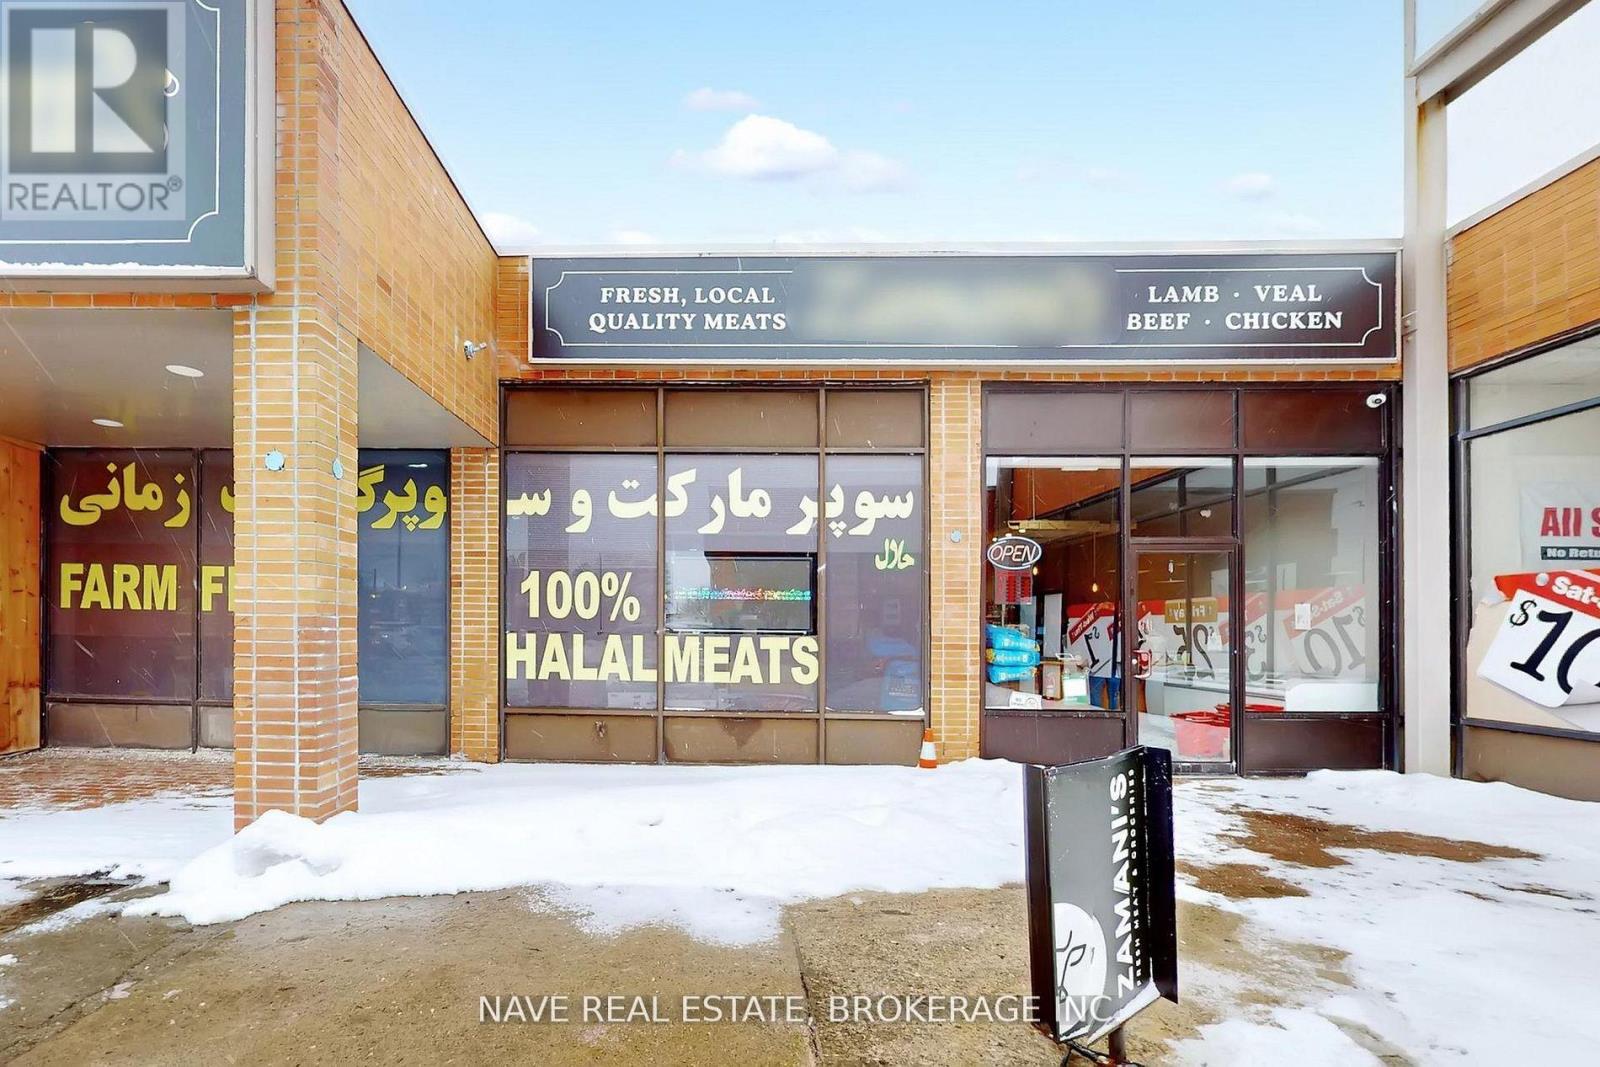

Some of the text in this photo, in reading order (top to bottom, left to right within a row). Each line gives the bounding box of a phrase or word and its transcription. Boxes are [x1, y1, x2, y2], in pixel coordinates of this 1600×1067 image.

[600, 287, 775, 307] FRESH, LOCAL
[1148, 284, 1323, 303] LAMB VEAL
[588, 313, 786, 333] QUALITY MEATS
[1126, 311, 1343, 330] BEEF CHICKEN
[1541, 507, 1582, 537] All
[990, 545, 1036, 562] OPEN
[1546, 548, 1567, 558] No
[60, 563, 177, 611] FARM
[520, 570, 641, 622] 100%
[1552, 575, 1600, 609] Sat-
[506, 633, 820, 685] HALAL MEATS
[1110, 773, 1135, 999] ZAMANI'S
